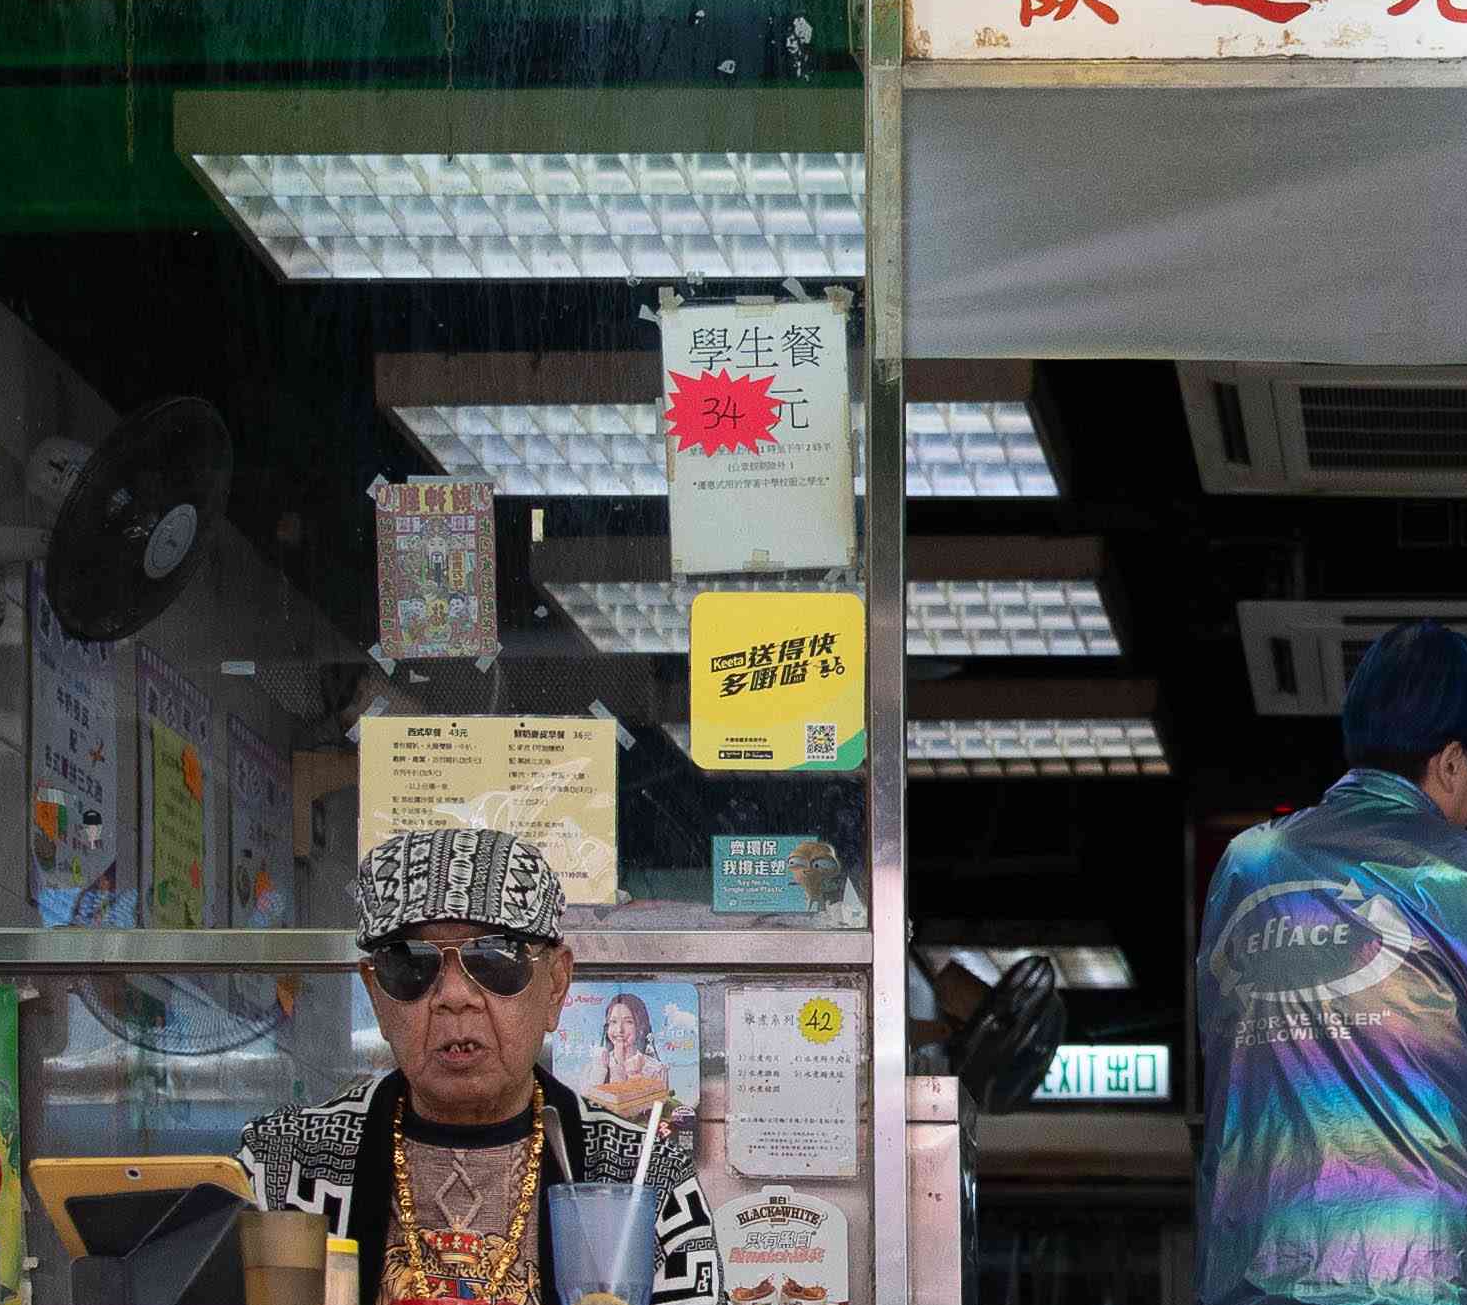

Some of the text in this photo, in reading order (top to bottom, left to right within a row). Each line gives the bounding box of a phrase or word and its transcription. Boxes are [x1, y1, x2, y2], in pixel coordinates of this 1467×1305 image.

[688, 324, 824, 371] 學生餐
[701, 395, 746, 430] 34
[712, 653, 746, 672] Keeta
[746, 631, 840, 669] 送得快
[804, 1008, 834, 1033] 42
[1106, 1054, 1157, 1092] 出口
